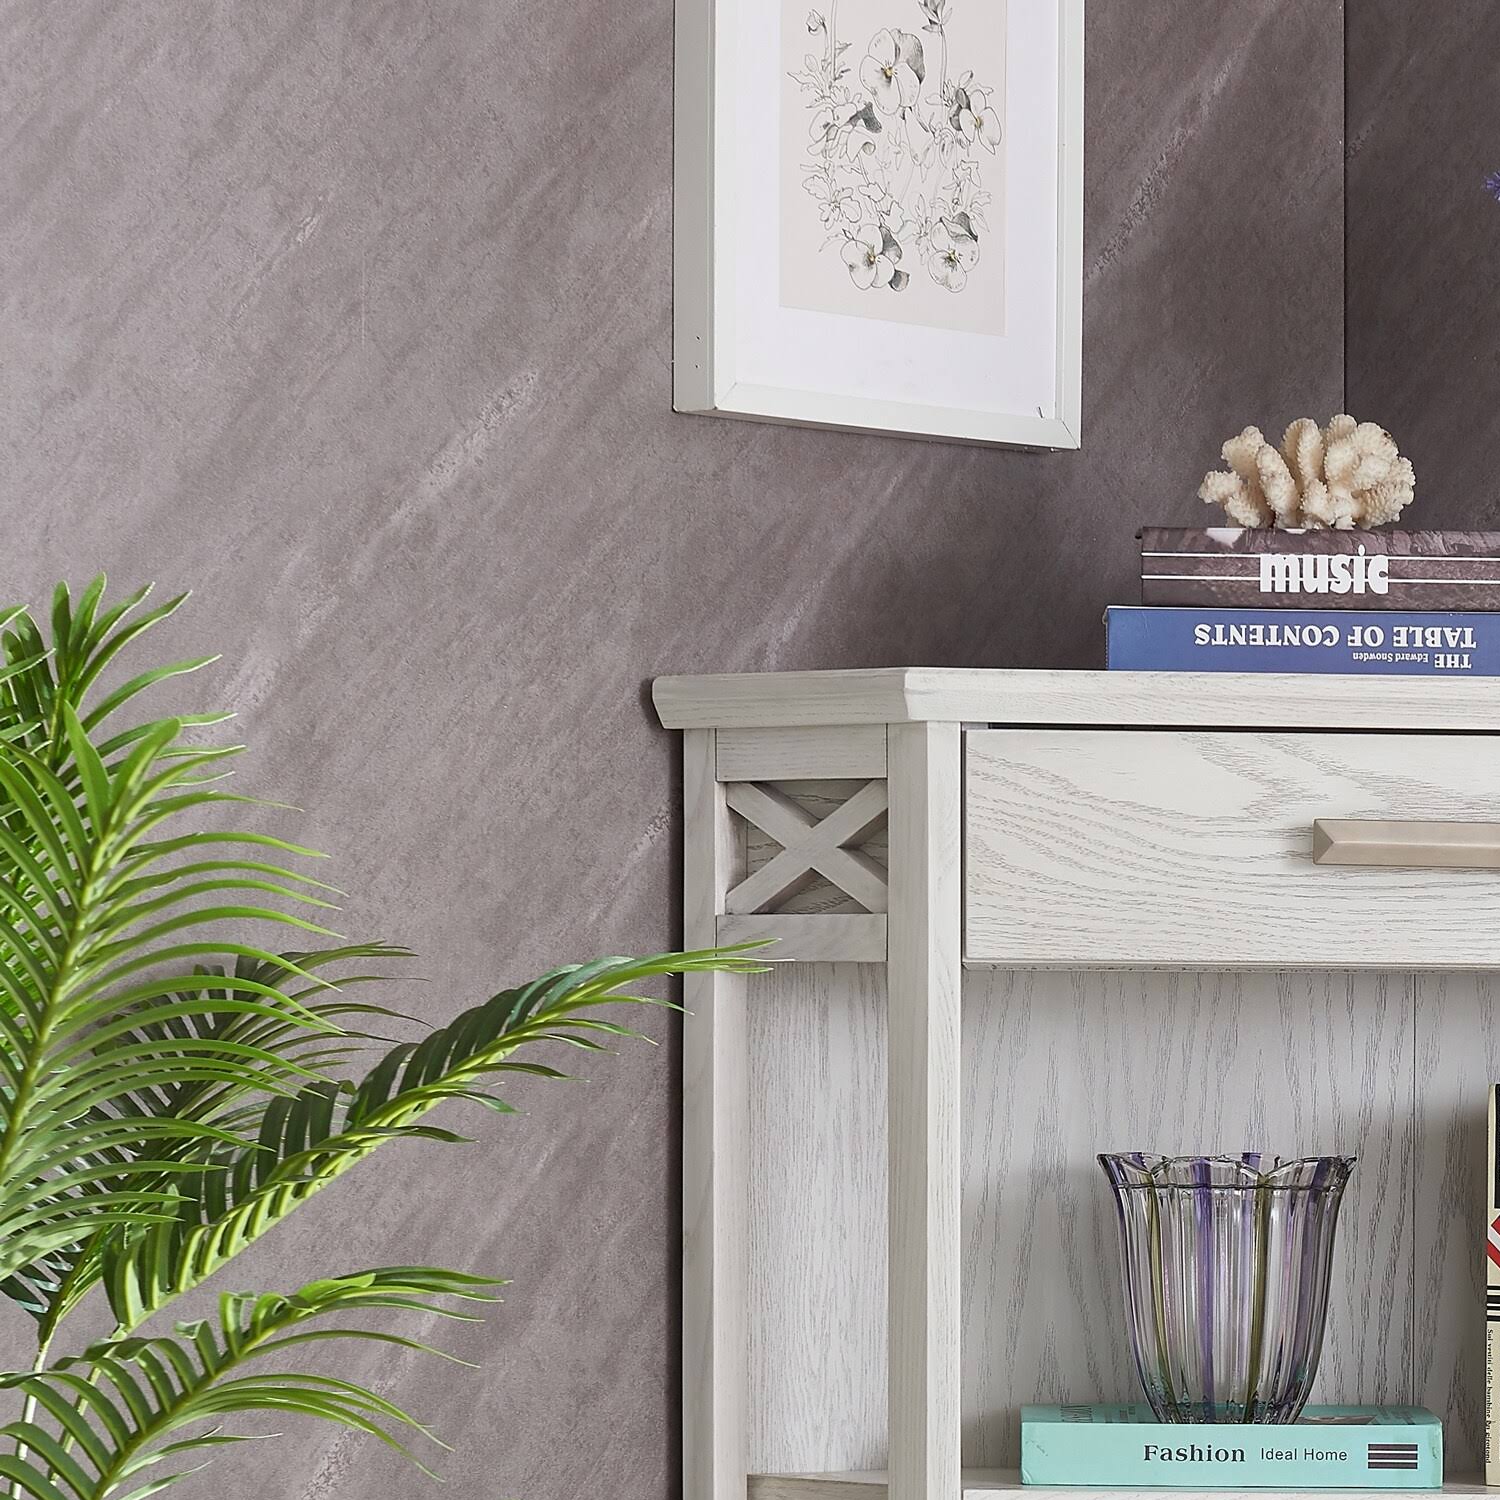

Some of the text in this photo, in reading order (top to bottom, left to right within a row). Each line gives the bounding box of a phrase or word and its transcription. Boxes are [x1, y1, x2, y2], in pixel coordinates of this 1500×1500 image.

[1259, 544, 1389, 594] music
[1194, 623, 1477, 649] TABLE OF CONTENTS
[1352, 652, 1472, 669] THE Edward Snowden
[1144, 1444, 1348, 1462] Fashion Ideal Home
